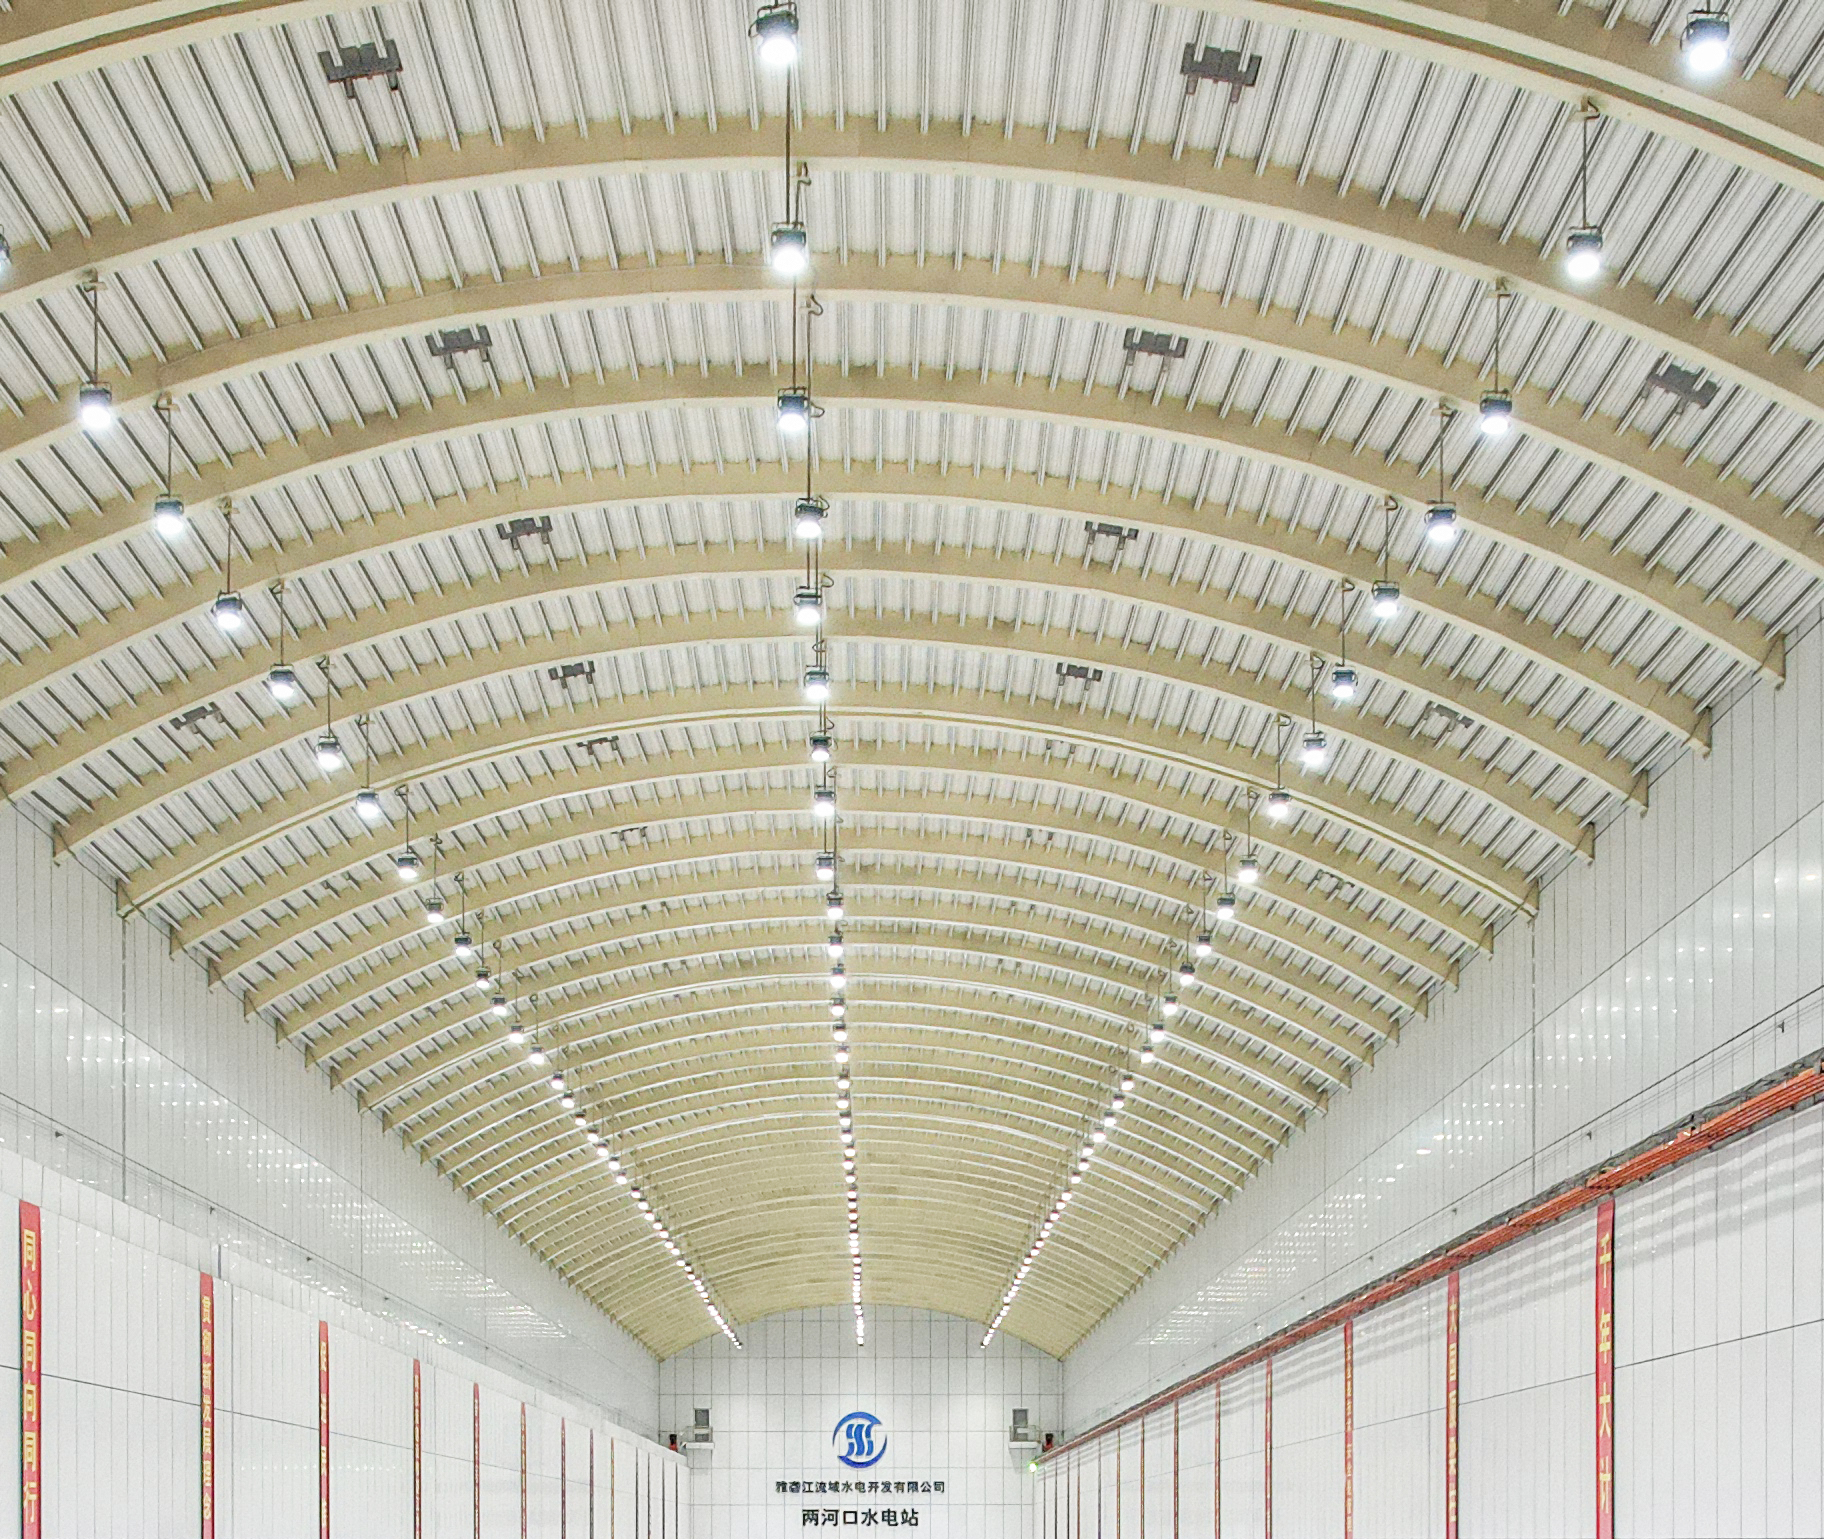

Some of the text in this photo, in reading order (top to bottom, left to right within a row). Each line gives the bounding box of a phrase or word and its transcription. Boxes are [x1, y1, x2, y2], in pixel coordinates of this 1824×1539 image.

[22, 1229, 38, 1524] 同心同向同行
[1598, 1232, 1612, 1511] 千年大计
[775, 1480, 945, 1494] 雅砻江流域水电开发有限公司
[801, 1508, 919, 1528] 两河口水电站
